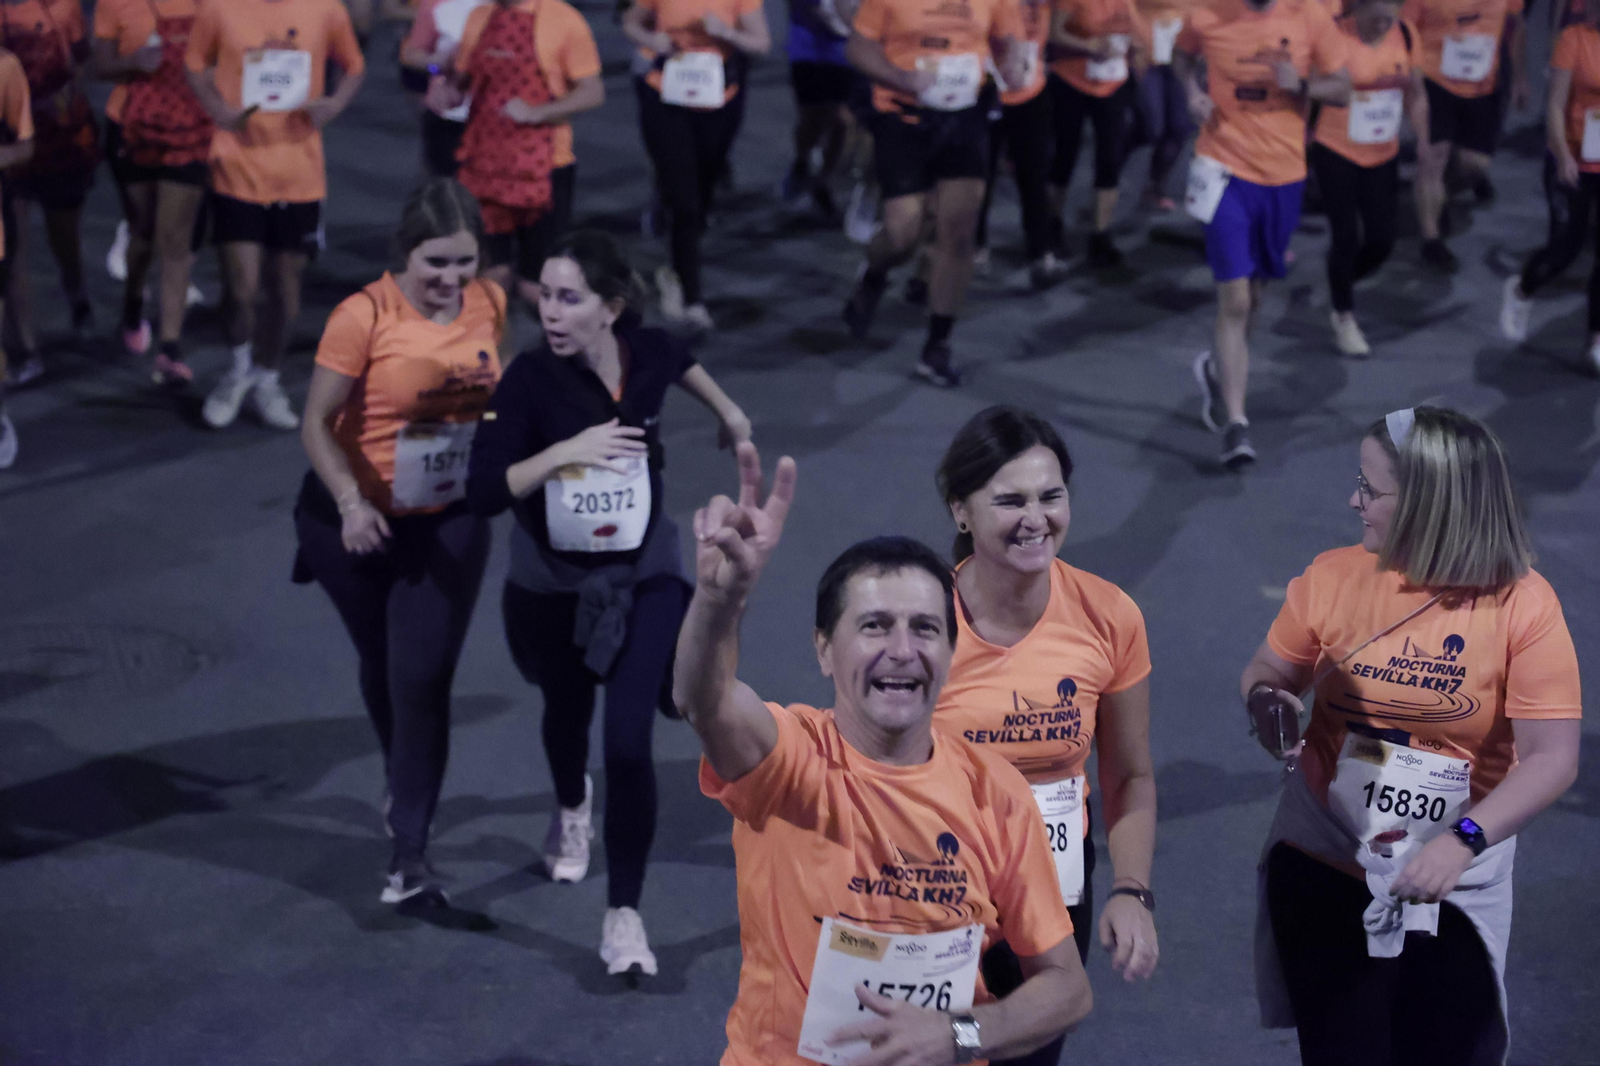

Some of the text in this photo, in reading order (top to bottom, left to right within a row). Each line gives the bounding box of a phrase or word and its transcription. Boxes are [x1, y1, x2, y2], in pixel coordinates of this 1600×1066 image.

[572, 487, 635, 514] 20372
[1350, 663, 1417, 687] SEVILLA
[1387, 656, 1467, 678] NOCTURNA
[1003, 707, 1081, 727] NOCTURNA
[963, 728, 1042, 743] SEVILLA
[1362, 781, 1446, 822] 15830
[880, 863, 967, 884] NOCTURNA
[847, 875, 919, 902] SEVILLA
